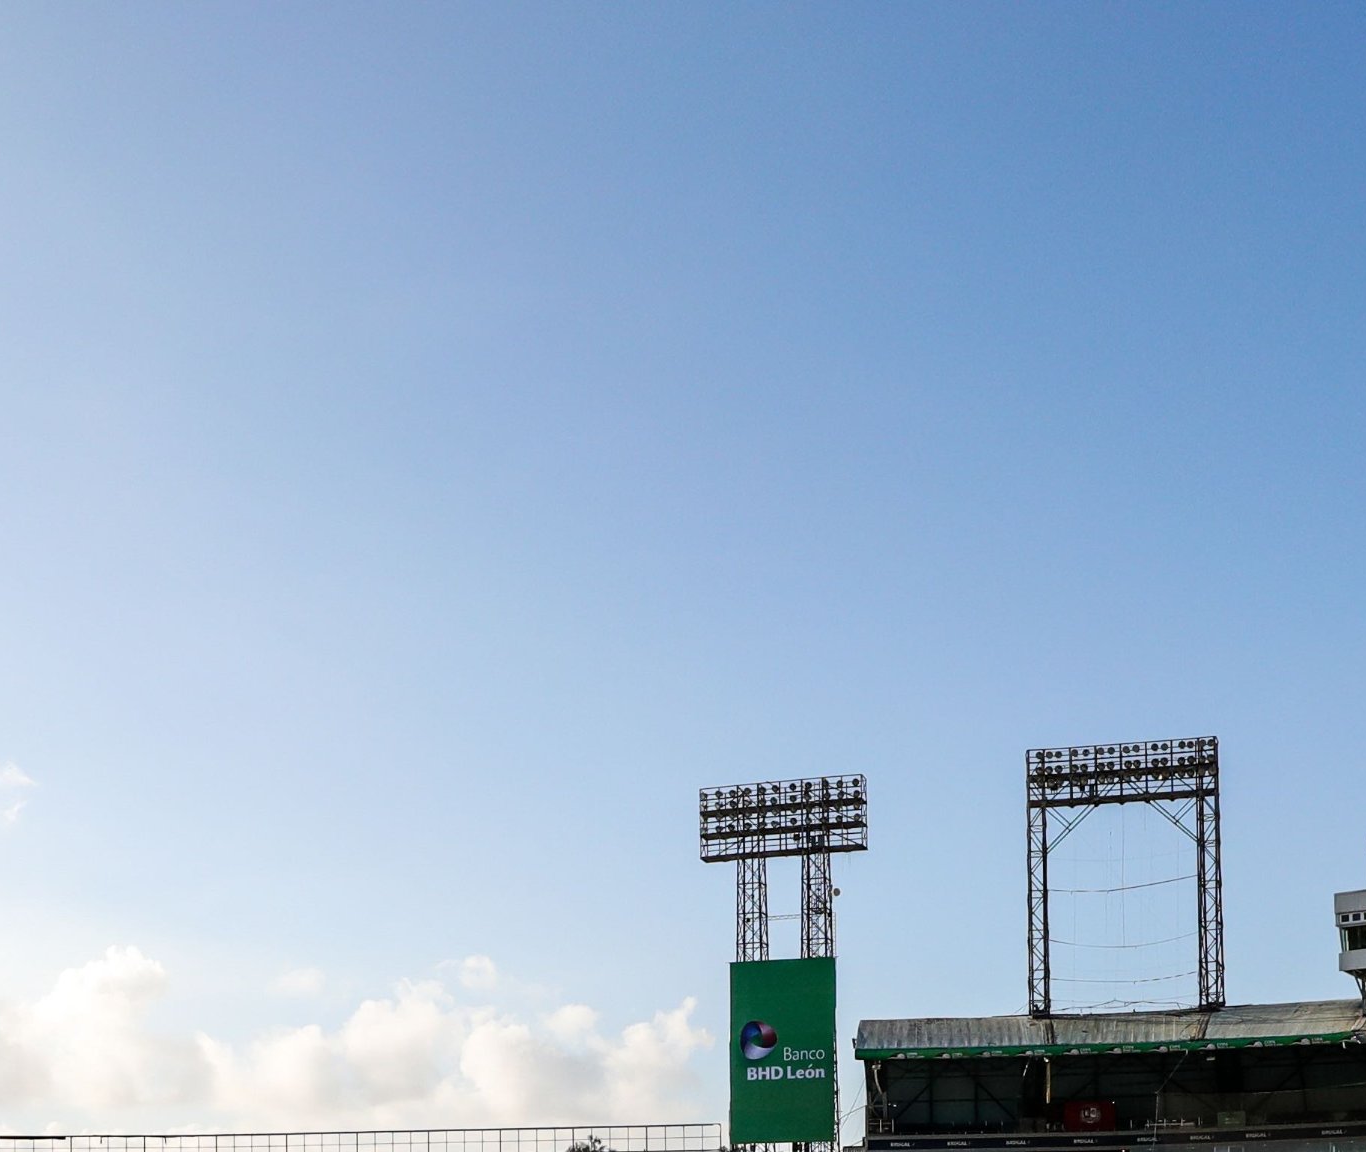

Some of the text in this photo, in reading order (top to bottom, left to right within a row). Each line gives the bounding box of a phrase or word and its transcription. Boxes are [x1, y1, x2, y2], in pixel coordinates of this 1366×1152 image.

[783, 1047, 825, 1061] Banco
[747, 1064, 825, 1080] BHD León
